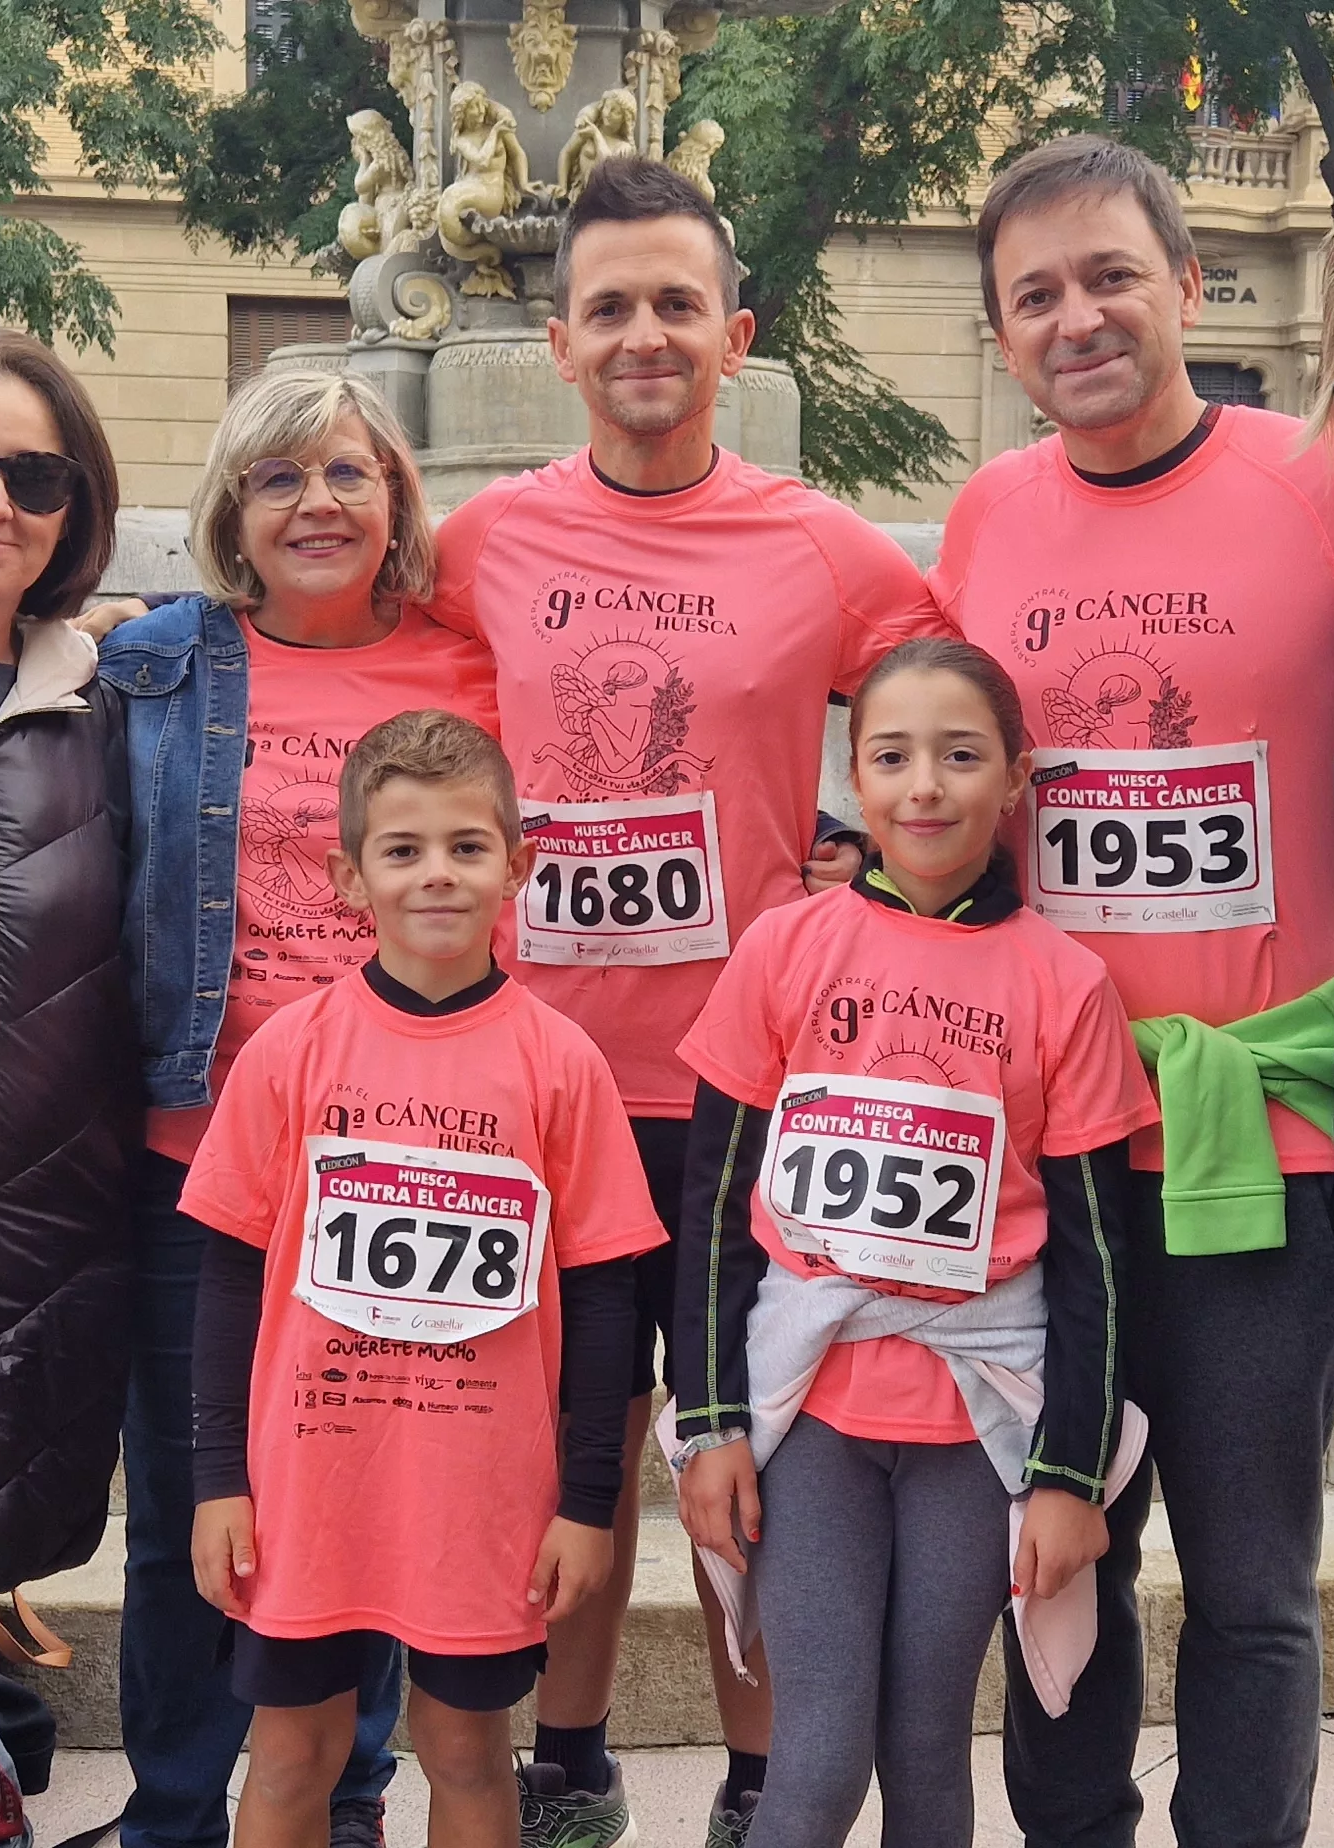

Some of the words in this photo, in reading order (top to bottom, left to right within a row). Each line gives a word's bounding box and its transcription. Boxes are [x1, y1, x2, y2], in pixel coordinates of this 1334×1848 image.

[536, 571, 578, 597] CONTRA
[578, 575, 593, 587] EL
[594, 584, 716, 617] CÁNCER
[1075, 590, 1209, 621] CÁNCER
[654, 615, 738, 636] HUESCA
[1141, 617, 1236, 636] HUESCA
[281, 732, 360, 759] CÁN
[1108, 774, 1168, 788] HUESCA
[1046, 787, 1124, 807] CONTRA
[1129, 790, 1152, 807] EL
[1156, 783, 1243, 806] CÁNCER
[573, 823, 627, 837] HUESCA
[592, 839, 613, 855] EL
[617, 830, 694, 852] CÁNCER
[1045, 814, 1249, 888] 1953
[536, 858, 701, 926] 1680
[1155, 907, 1198, 919] castellar
[332, 924, 377, 942] MUCH
[815, 976, 861, 1006] CONTRA
[863, 978, 877, 991] EL
[881, 987, 1005, 1039] CÁNCER
[811, 1009, 845, 1061] CARRERA
[940, 1026, 1013, 1065] HUESCA
[375, 1097, 499, 1138] CÁNCER
[853, 1101, 914, 1122] HUESCA
[438, 1133, 516, 1158] HUESCA
[790, 1112, 865, 1136] CONTRA
[870, 1120, 893, 1140] EL
[899, 1122, 981, 1154] CÁNCER
[398, 1169, 457, 1189] HUESCA
[781, 1144, 977, 1240] 1952
[329, 1178, 412, 1205] CONTRA
[417, 1188, 439, 1208] EL
[443, 1189, 524, 1217] CÁNCER
[324, 1211, 521, 1300] 1678
[872, 1252, 916, 1268] castellar
[424, 1317, 465, 1331] castellar
